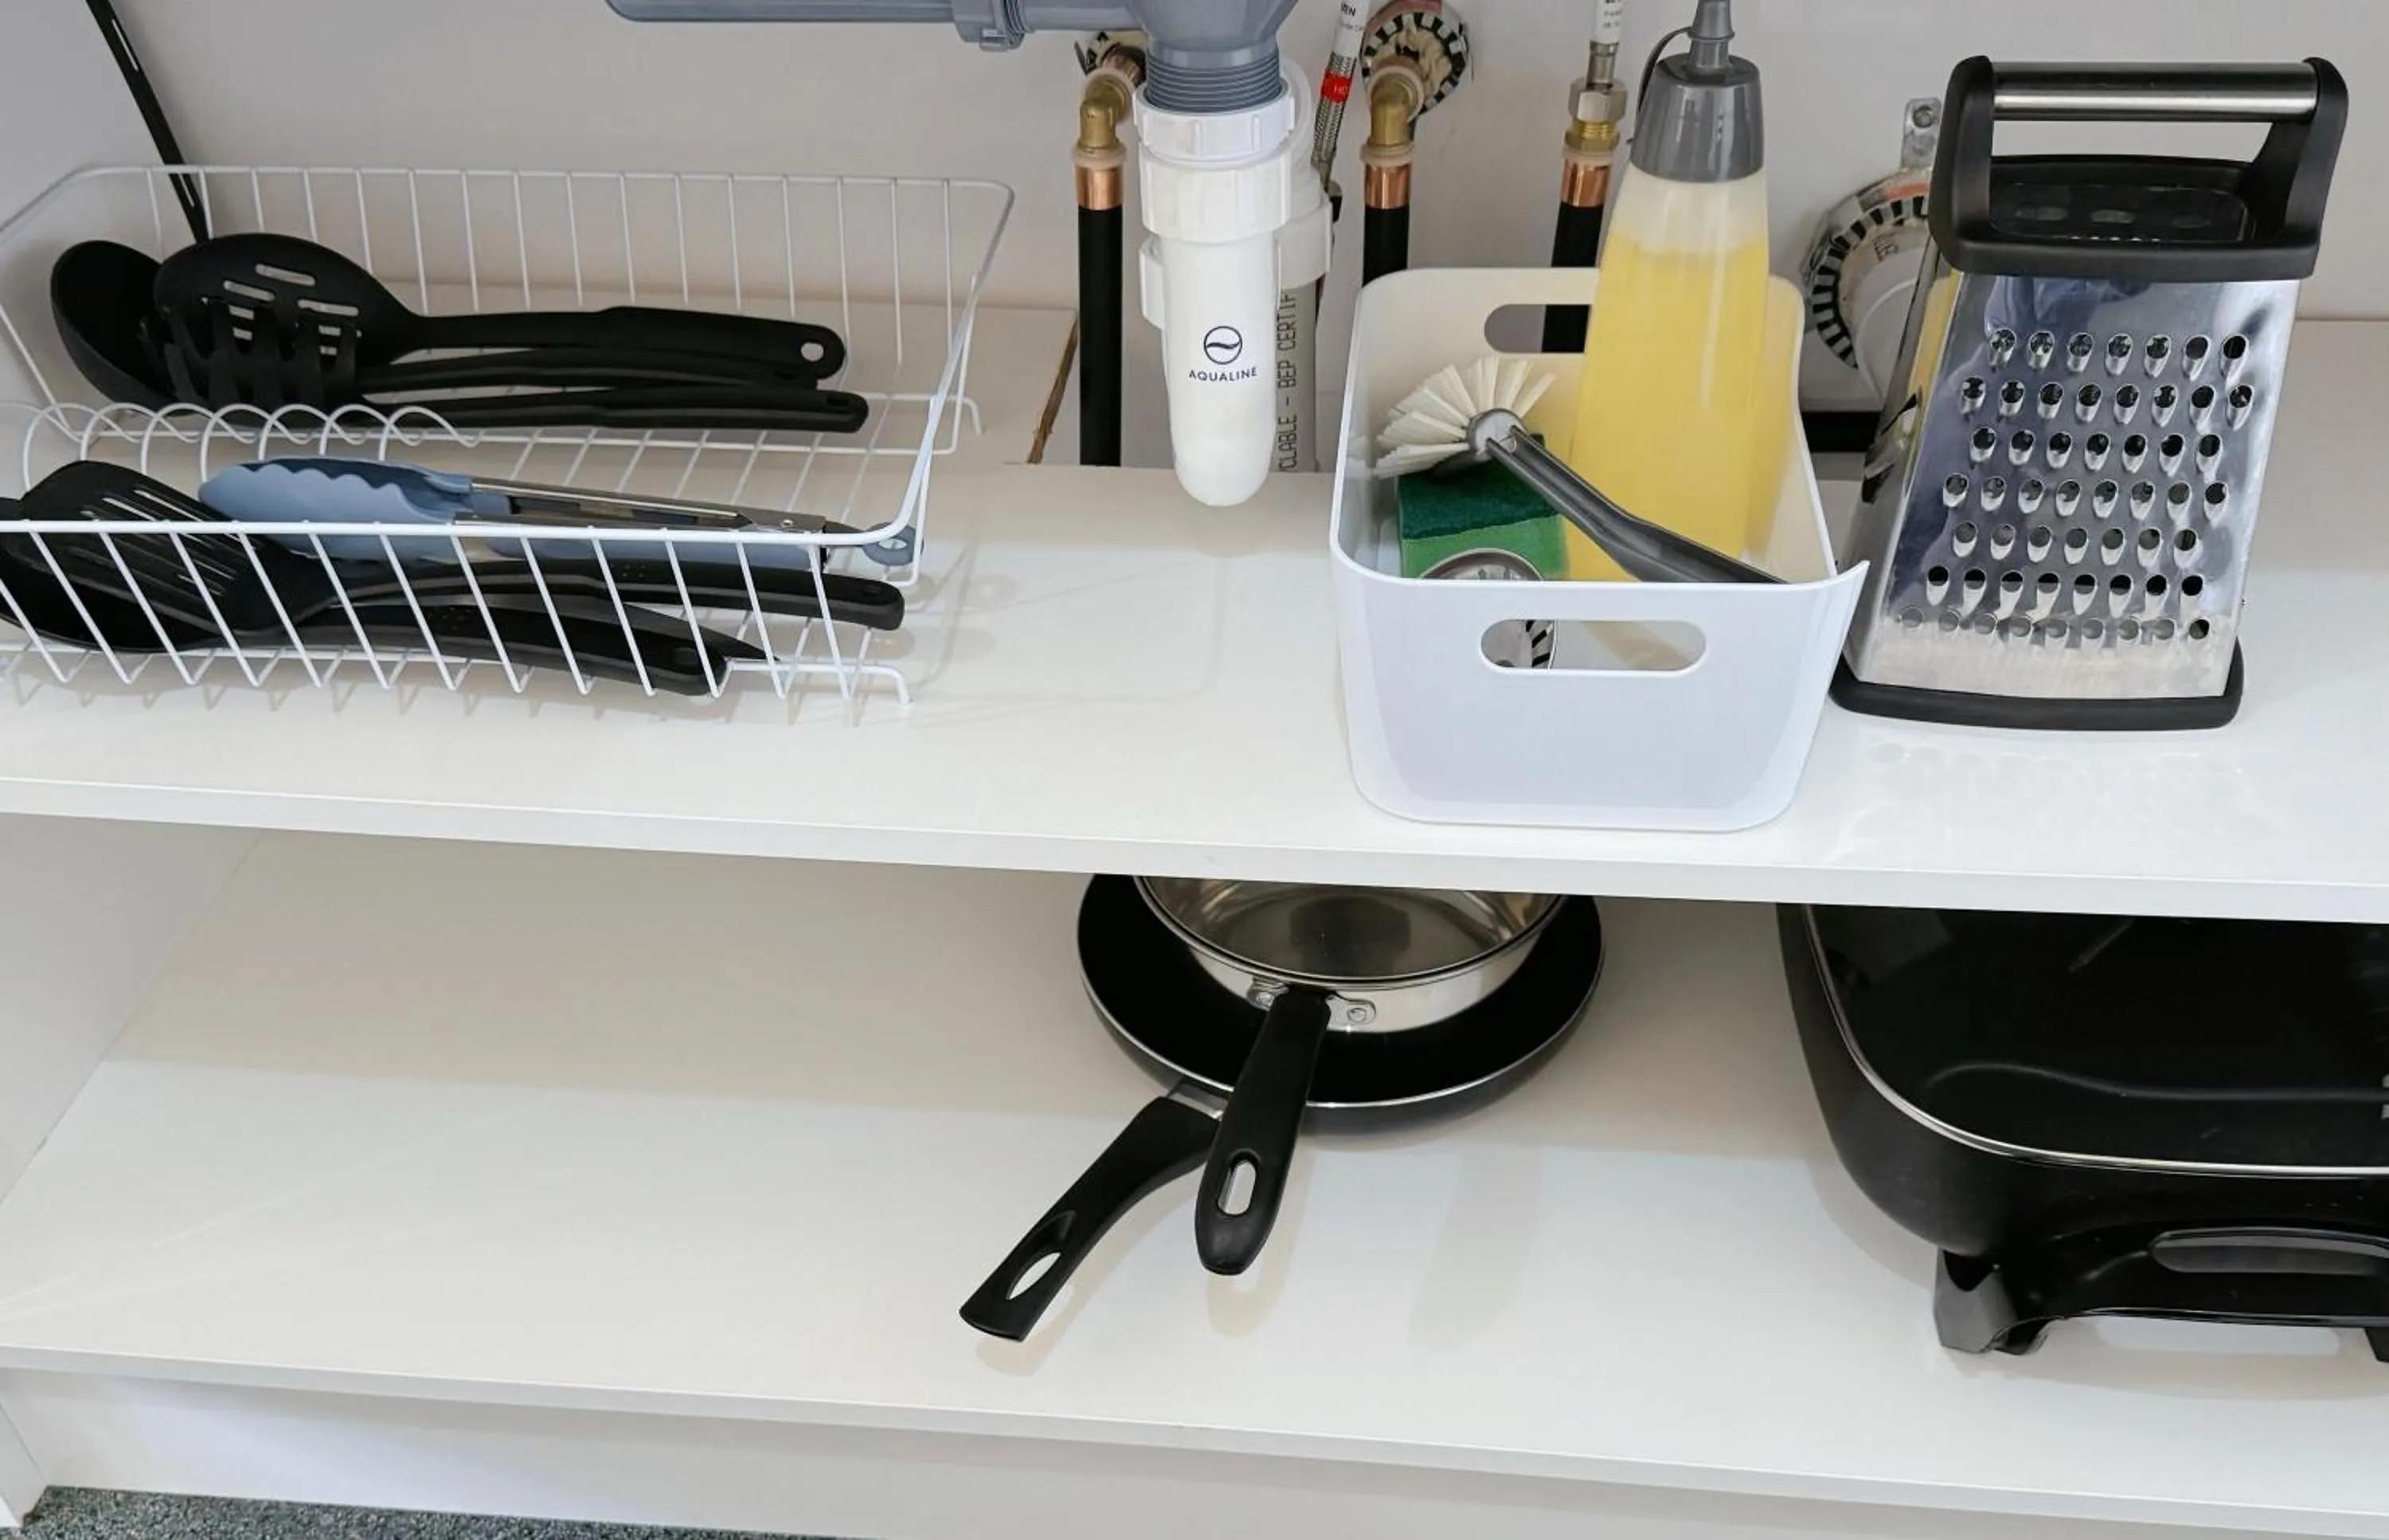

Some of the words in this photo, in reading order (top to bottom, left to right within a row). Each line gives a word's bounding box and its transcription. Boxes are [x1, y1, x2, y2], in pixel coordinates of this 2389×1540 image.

[1189, 367, 1257, 381] AQUALINE
[1277, 360, 1296, 389] BEP
[1277, 414, 1296, 471] CLABLE
